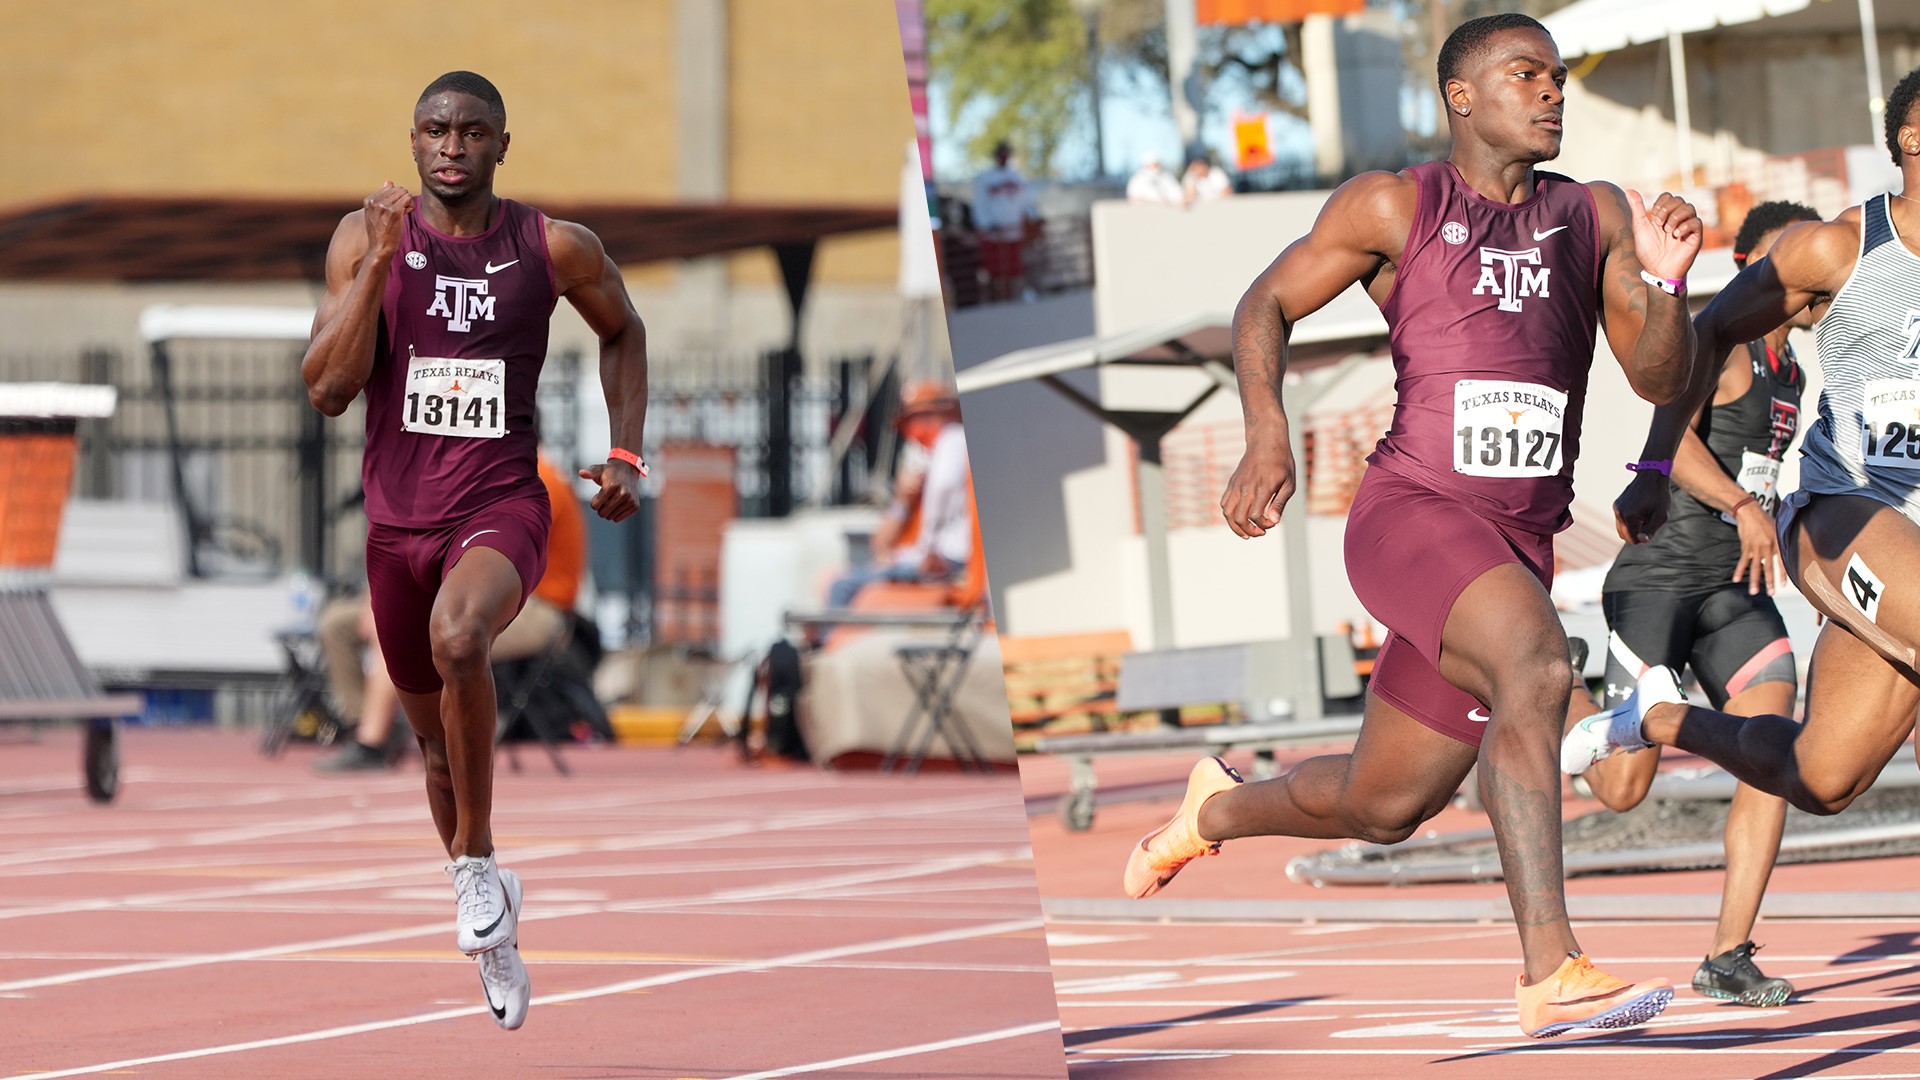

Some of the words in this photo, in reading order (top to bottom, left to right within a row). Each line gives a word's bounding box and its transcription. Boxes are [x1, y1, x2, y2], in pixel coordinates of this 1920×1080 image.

[1443, 225, 1466, 241] SEC
[407, 253, 426, 269] SEC
[414, 367, 451, 380] TEXAS
[455, 367, 500, 385] RELAYS
[1462, 391, 1509, 411] TEXAS
[1514, 391, 1561, 419] RELAYS
[1871, 390, 1916, 407] TEXAS
[407, 392, 498, 428] 13141
[1457, 426, 1561, 470] 13127
[1746, 466, 1769, 477] TEXAS
[1848, 565, 1878, 612] 4
